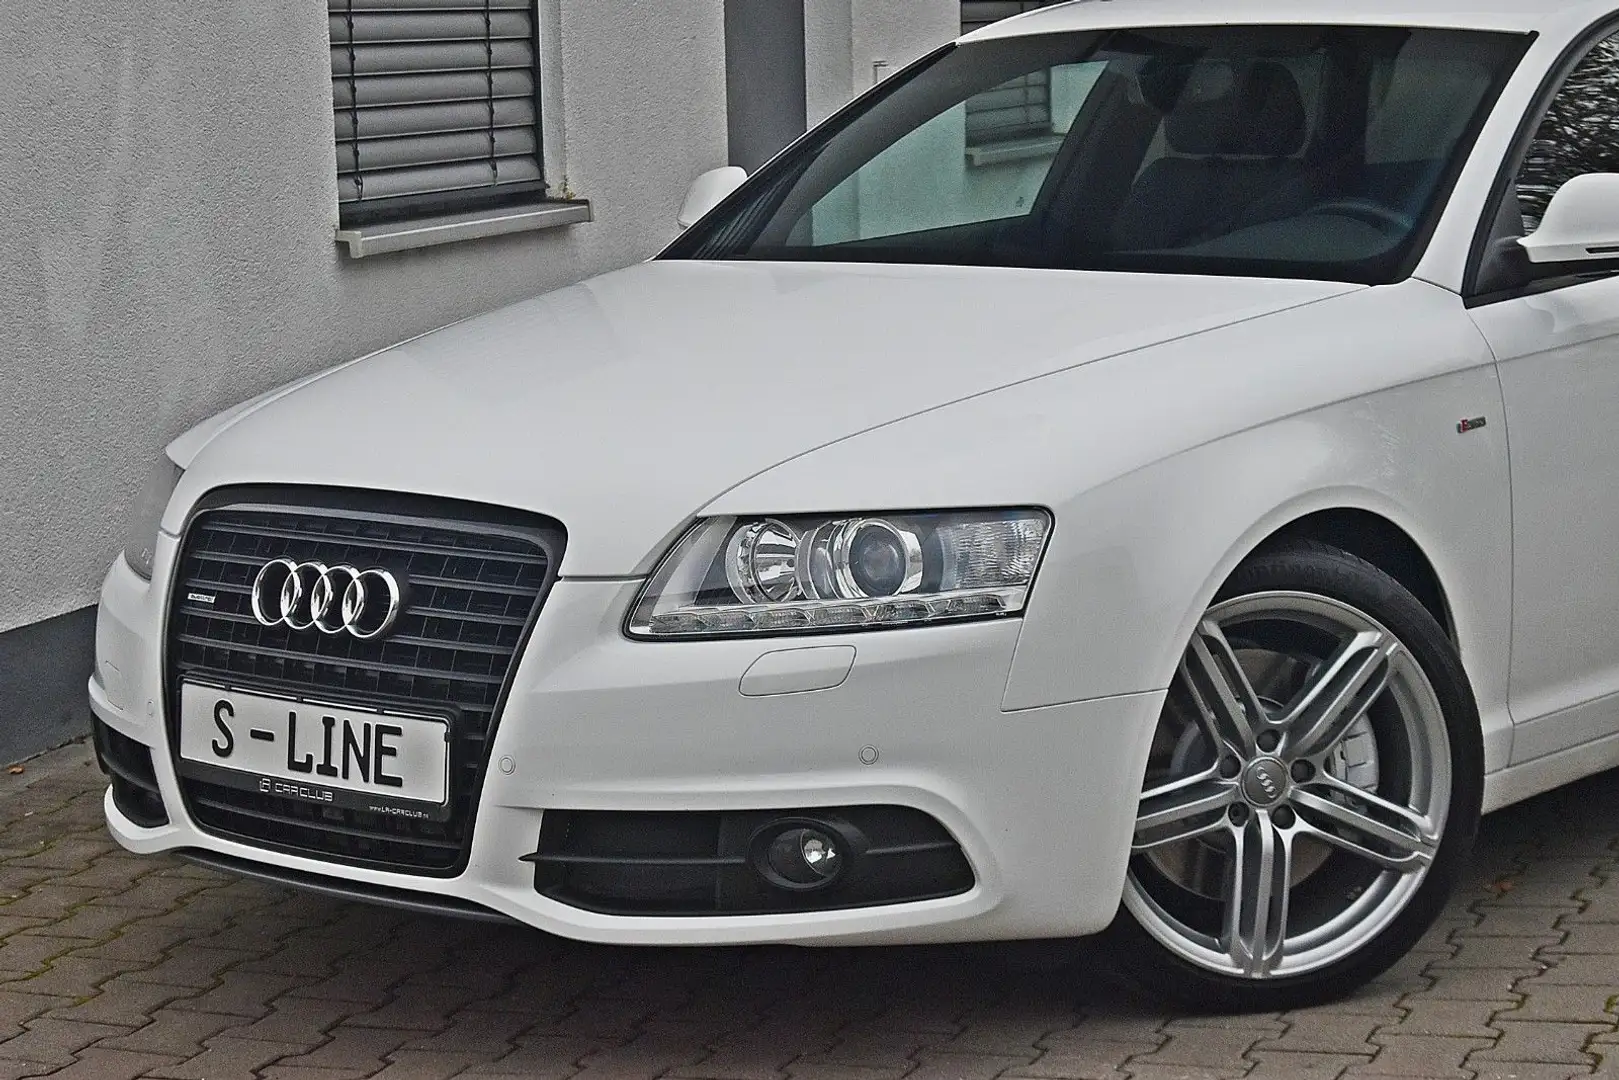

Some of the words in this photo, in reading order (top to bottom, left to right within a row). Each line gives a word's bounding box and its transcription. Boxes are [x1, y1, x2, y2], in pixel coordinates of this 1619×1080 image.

[212, 699, 235, 758] S
[287, 710, 403, 788] LINE
[275, 782, 334, 802] CARCLUB
